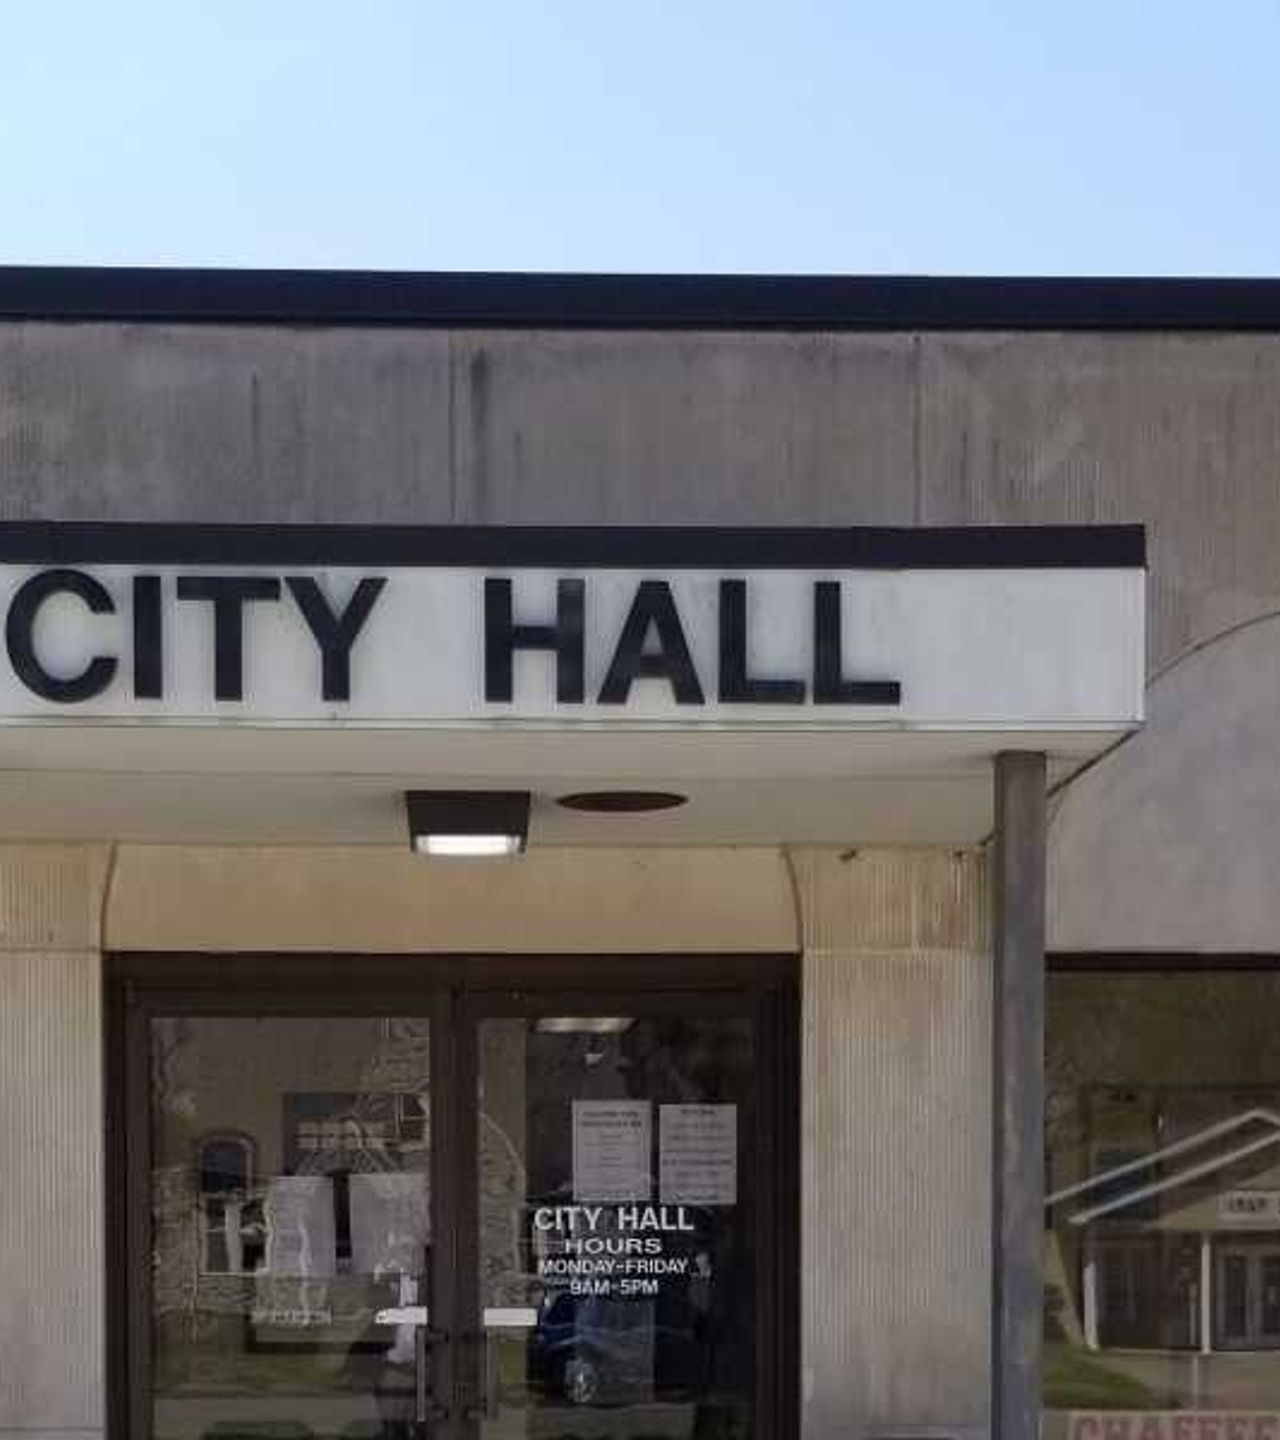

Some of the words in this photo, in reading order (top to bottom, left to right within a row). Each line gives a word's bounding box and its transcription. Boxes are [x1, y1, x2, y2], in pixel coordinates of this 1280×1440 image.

[5, 568, 387, 704] CITY
[484, 577, 902, 706] HALL
[533, 1206, 603, 1231] CITY
[617, 1206, 695, 1231] HALL
[564, 1237, 663, 1255] HOURS
[538, 1258, 689, 1275] MONDAY-FRIDAY
